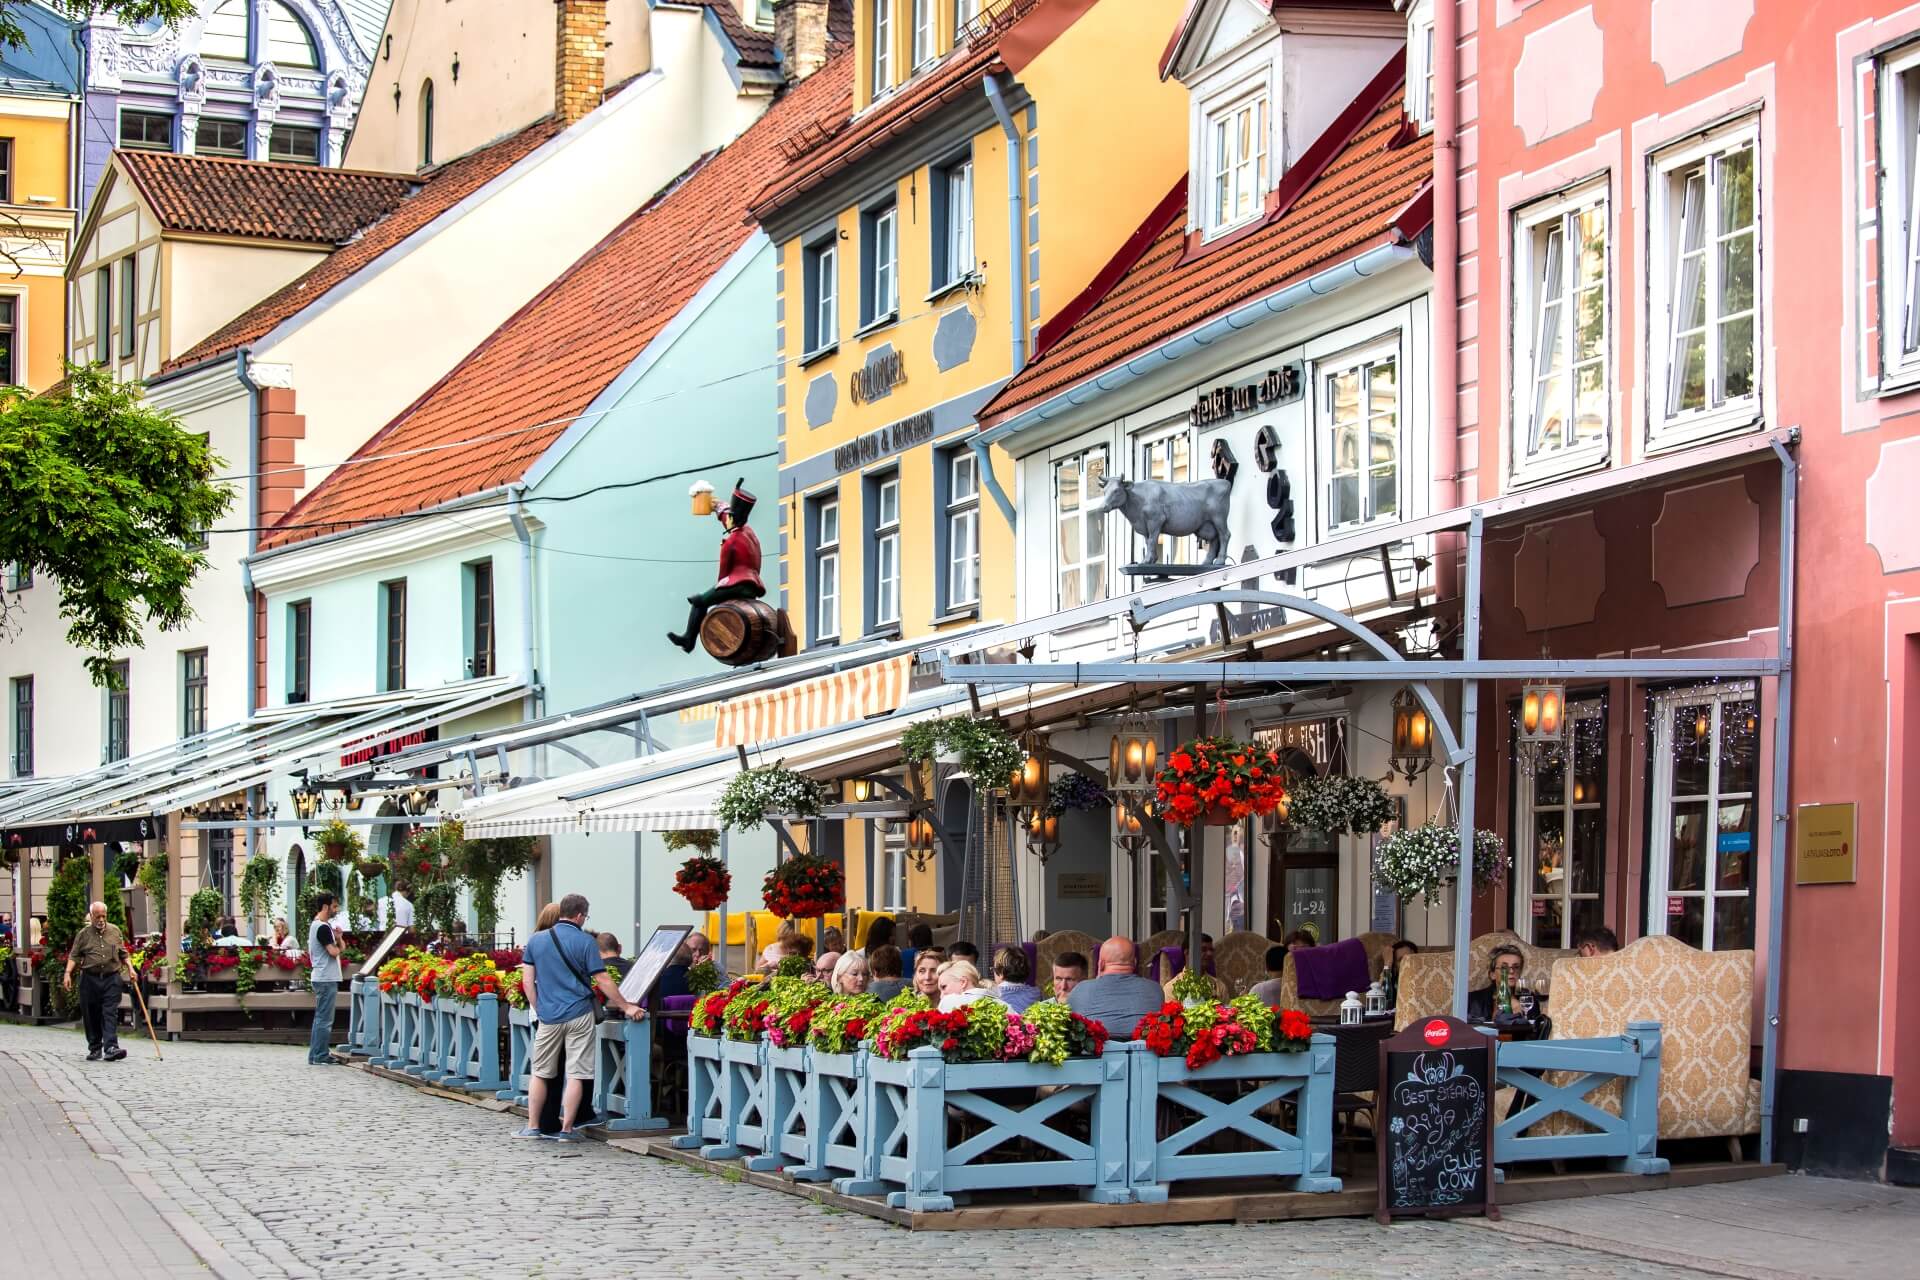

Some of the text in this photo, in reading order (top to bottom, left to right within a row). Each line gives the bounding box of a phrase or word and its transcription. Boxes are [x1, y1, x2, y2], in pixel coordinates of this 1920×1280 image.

[1288, 727, 1294, 744] &
[1301, 722, 1327, 764] FISH
[1293, 901, 1326, 915] 11-24
[1402, 1089, 1435, 1106] BEST
[1438, 1171, 1477, 1190] COW
